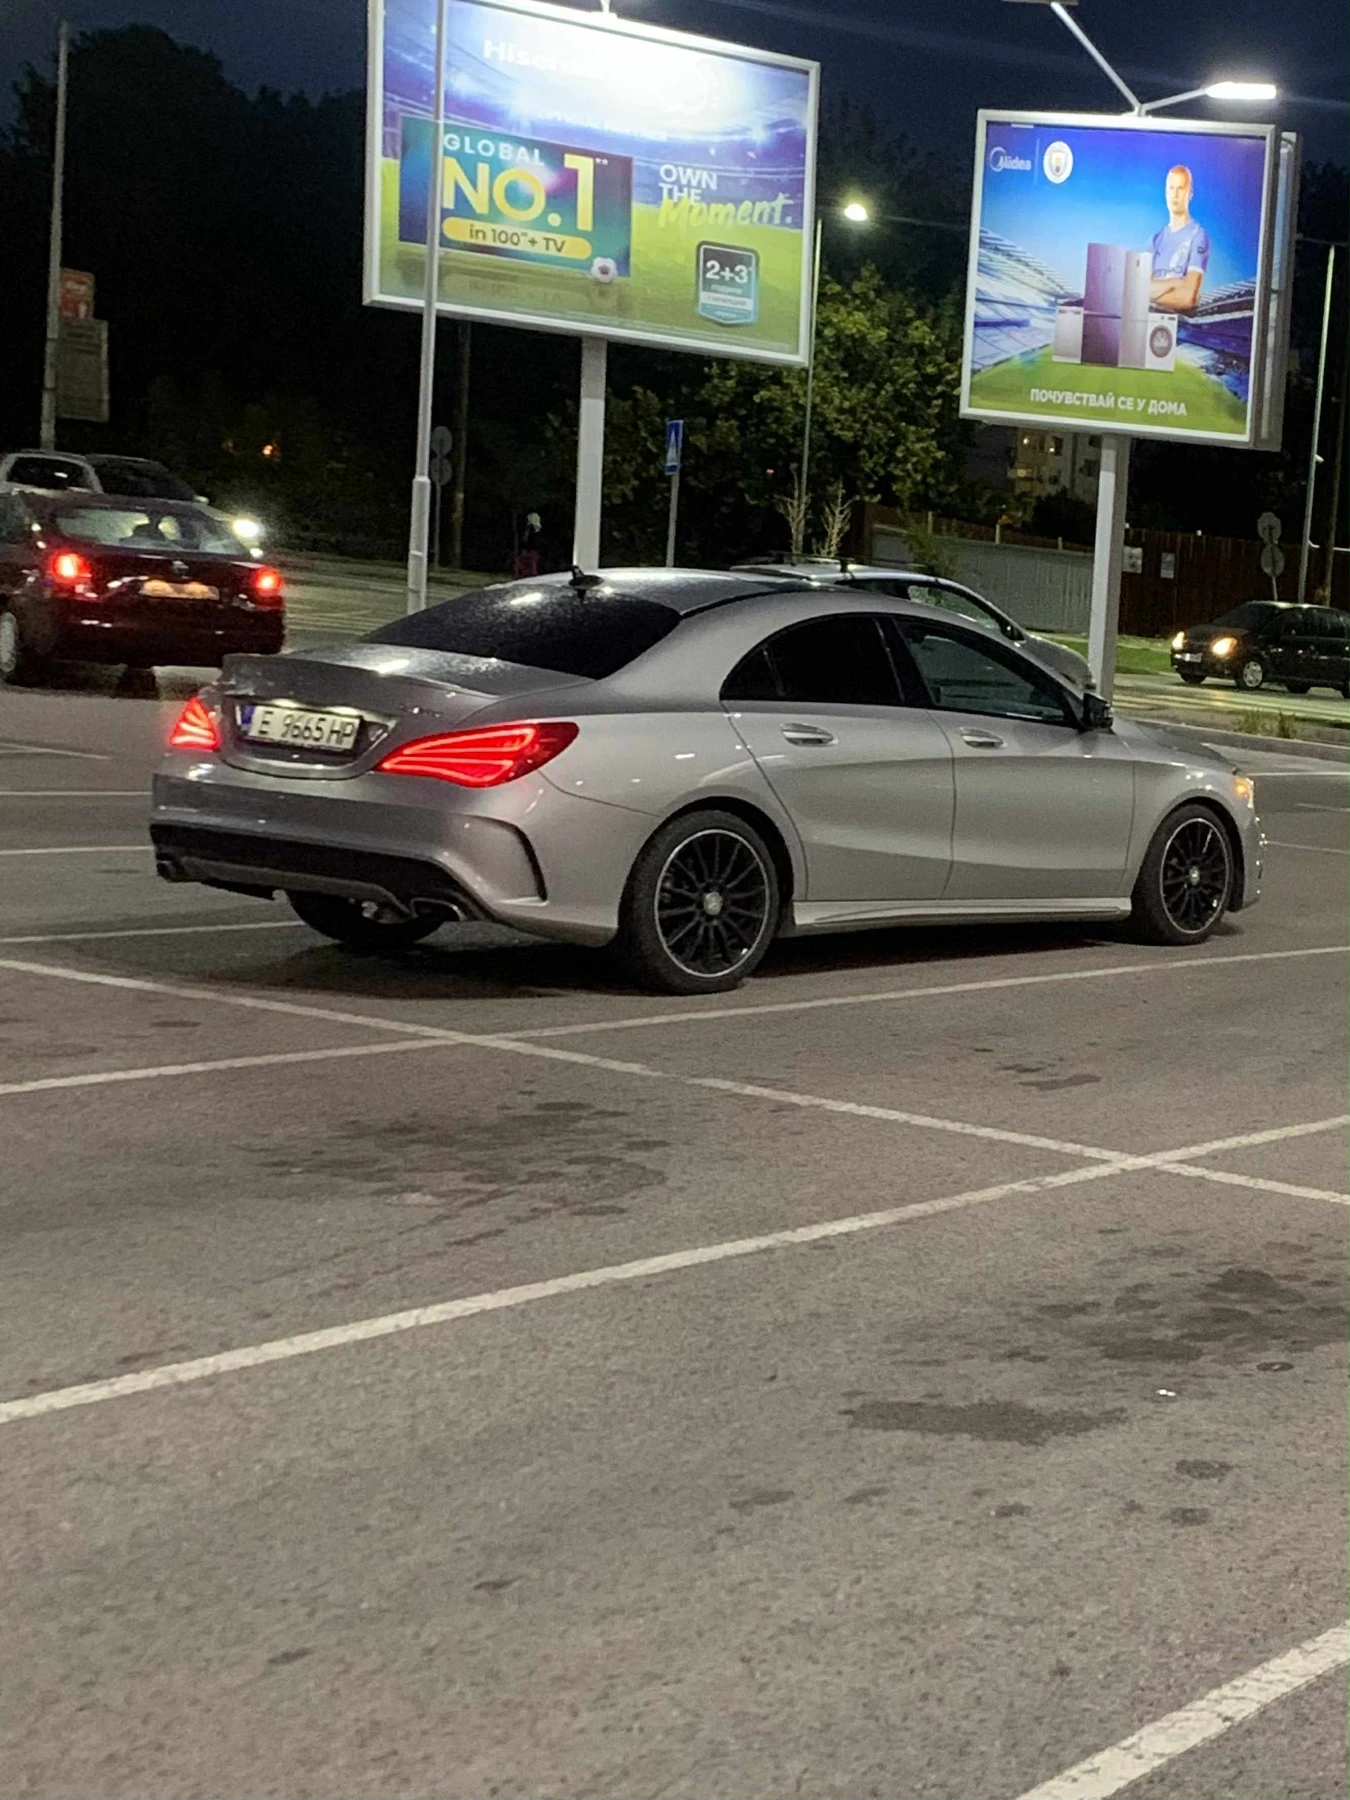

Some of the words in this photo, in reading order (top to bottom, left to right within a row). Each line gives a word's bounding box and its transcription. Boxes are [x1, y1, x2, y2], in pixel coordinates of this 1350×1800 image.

[443, 133, 545, 167] GLOBAL
[659, 164, 718, 191] OWN
[659, 183, 702, 204] THE
[659, 192, 794, 232] Moment.
[469, 224, 487, 241] in
[543, 237, 567, 254] TV
[1030, 389, 1115, 409] ПОЧУВСТВАЙ
[1118, 396, 1134, 411] СЕ
[1137, 398, 1147, 411] У
[1148, 399, 1188, 416] ДОМА
[258, 711, 274, 735] E
